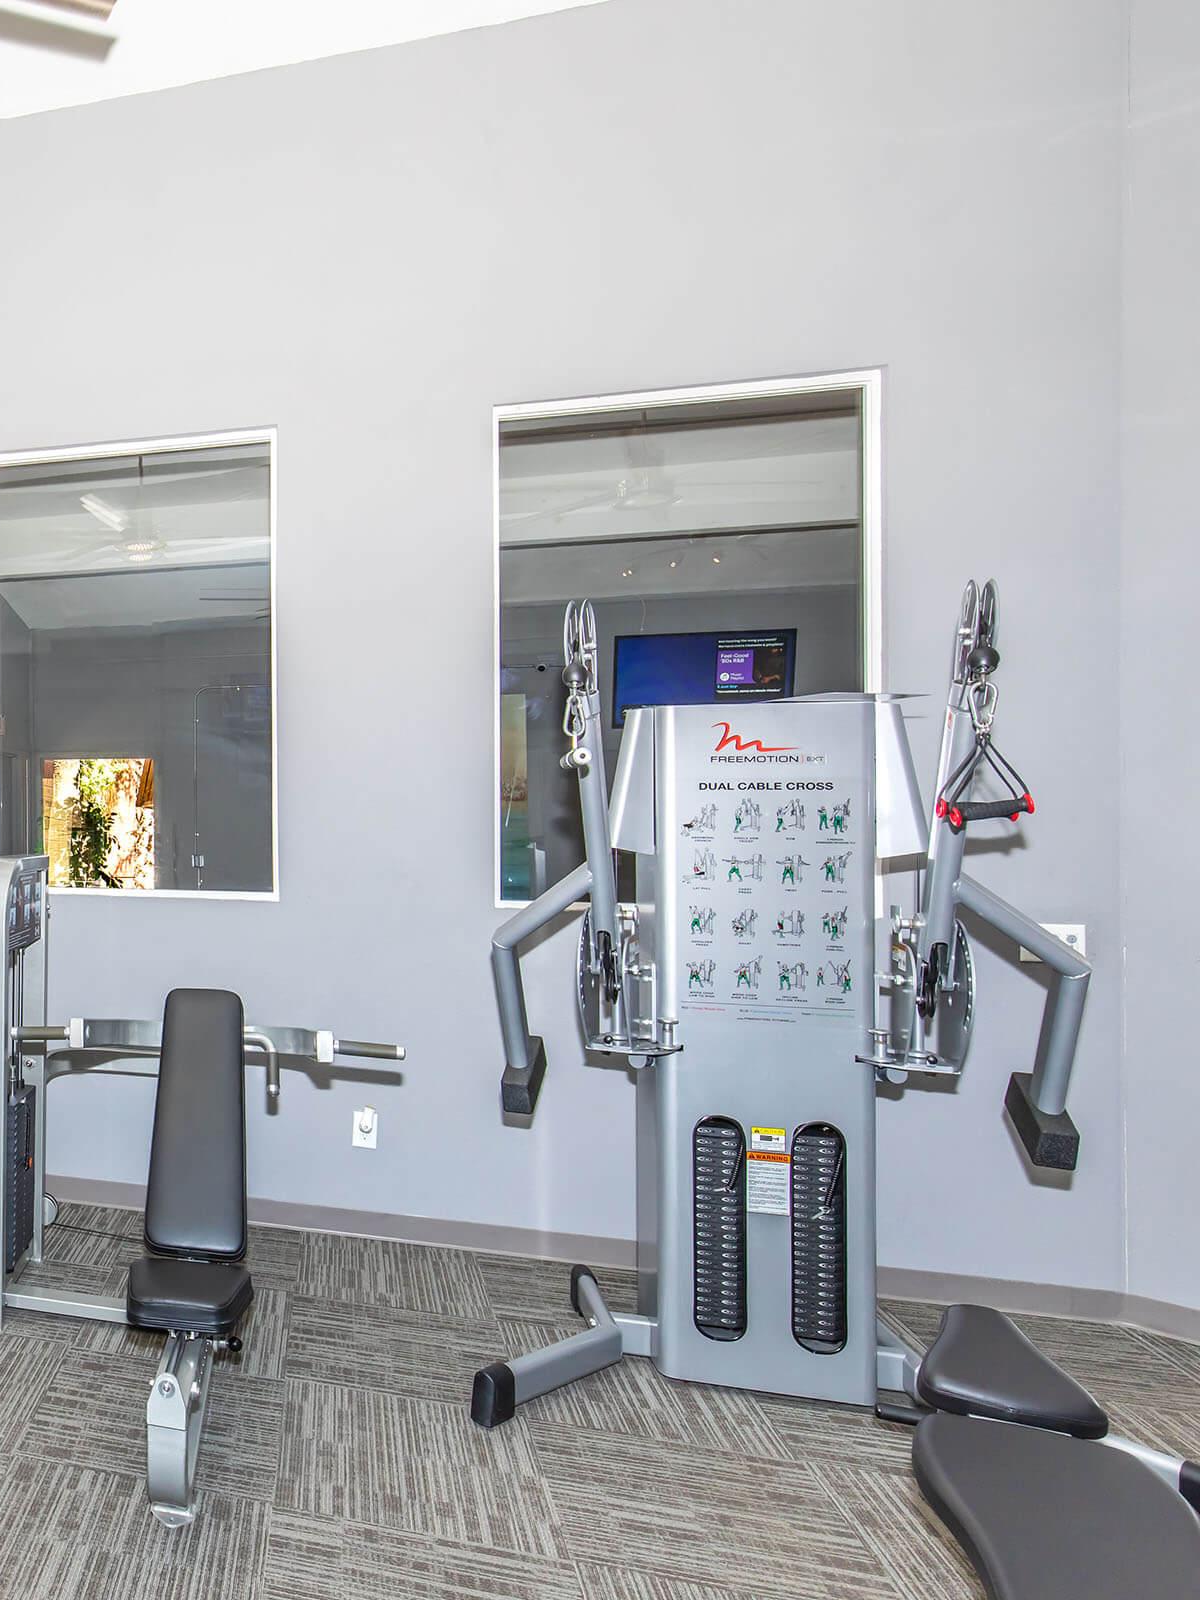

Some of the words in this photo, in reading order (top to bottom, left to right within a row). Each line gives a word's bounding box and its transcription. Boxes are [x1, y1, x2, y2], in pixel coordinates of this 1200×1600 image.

[710, 755, 799, 763] FREEMOTION
[699, 782, 734, 791] DUAL
[737, 782, 782, 791] CABLE
[786, 782, 834, 791] CROSS
[757, 1154, 789, 1162] WARNING
